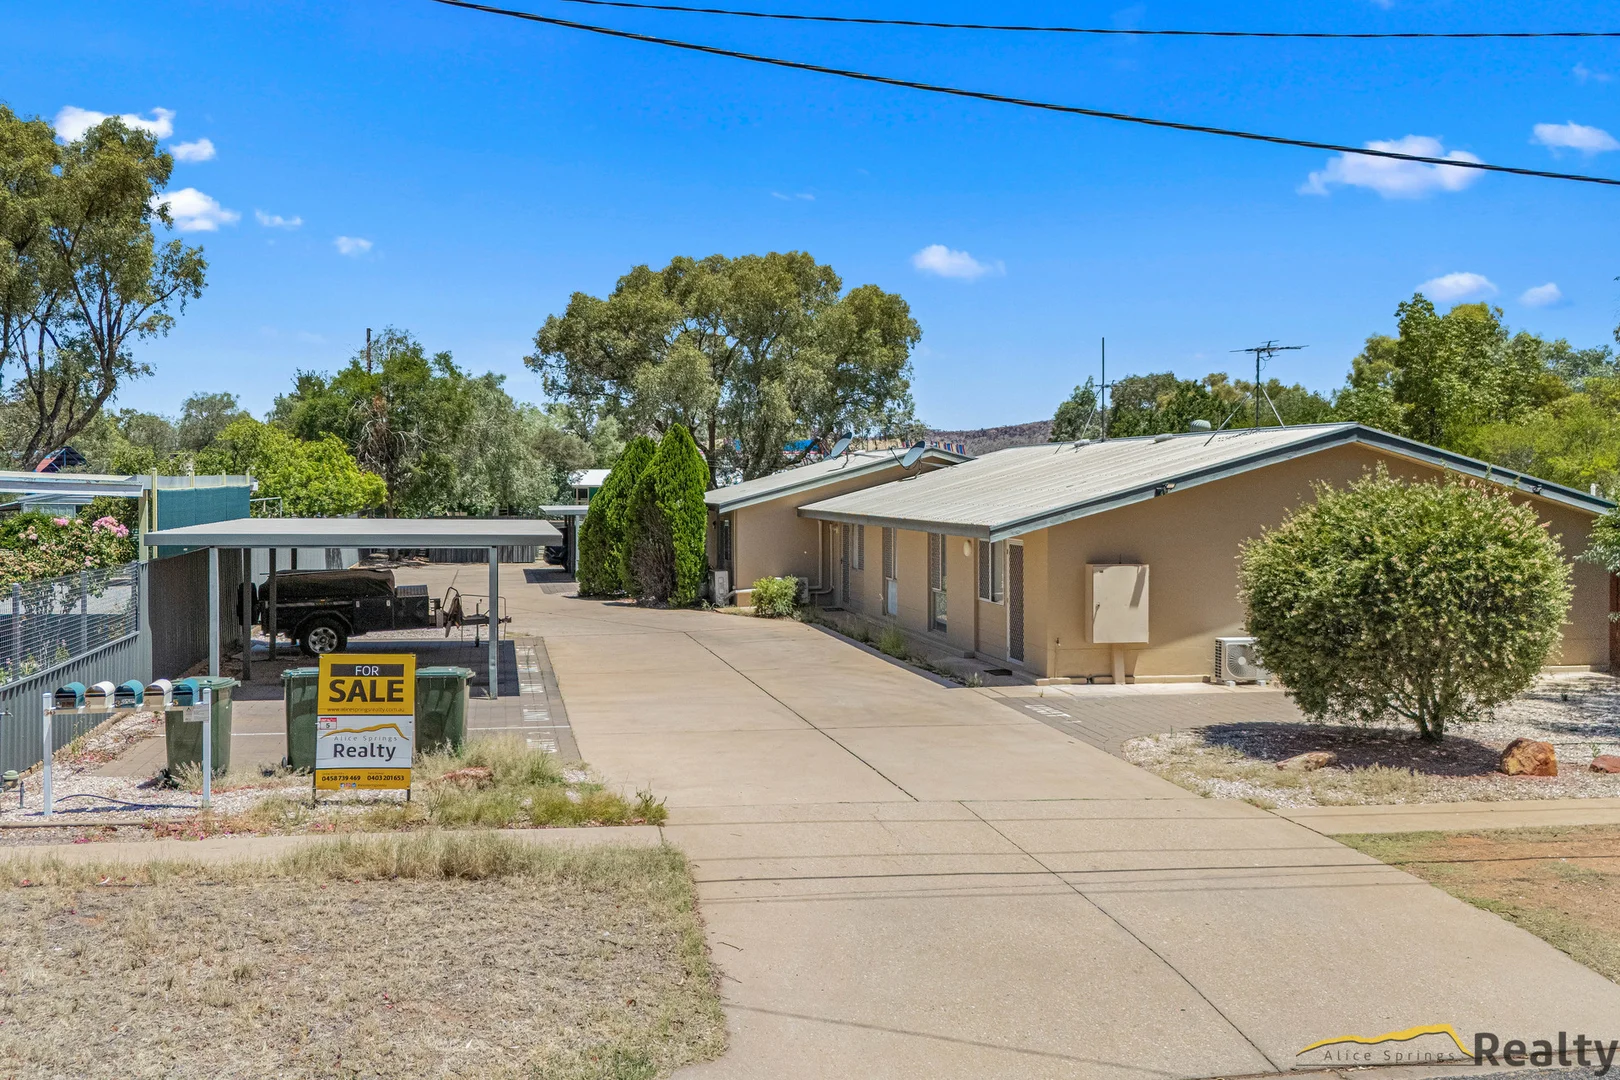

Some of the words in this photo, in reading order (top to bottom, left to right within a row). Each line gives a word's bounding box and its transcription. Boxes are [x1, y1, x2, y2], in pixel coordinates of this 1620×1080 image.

[355, 665, 379, 676] FOR
[328, 679, 404, 703] SALE
[333, 743, 397, 762] Realty
